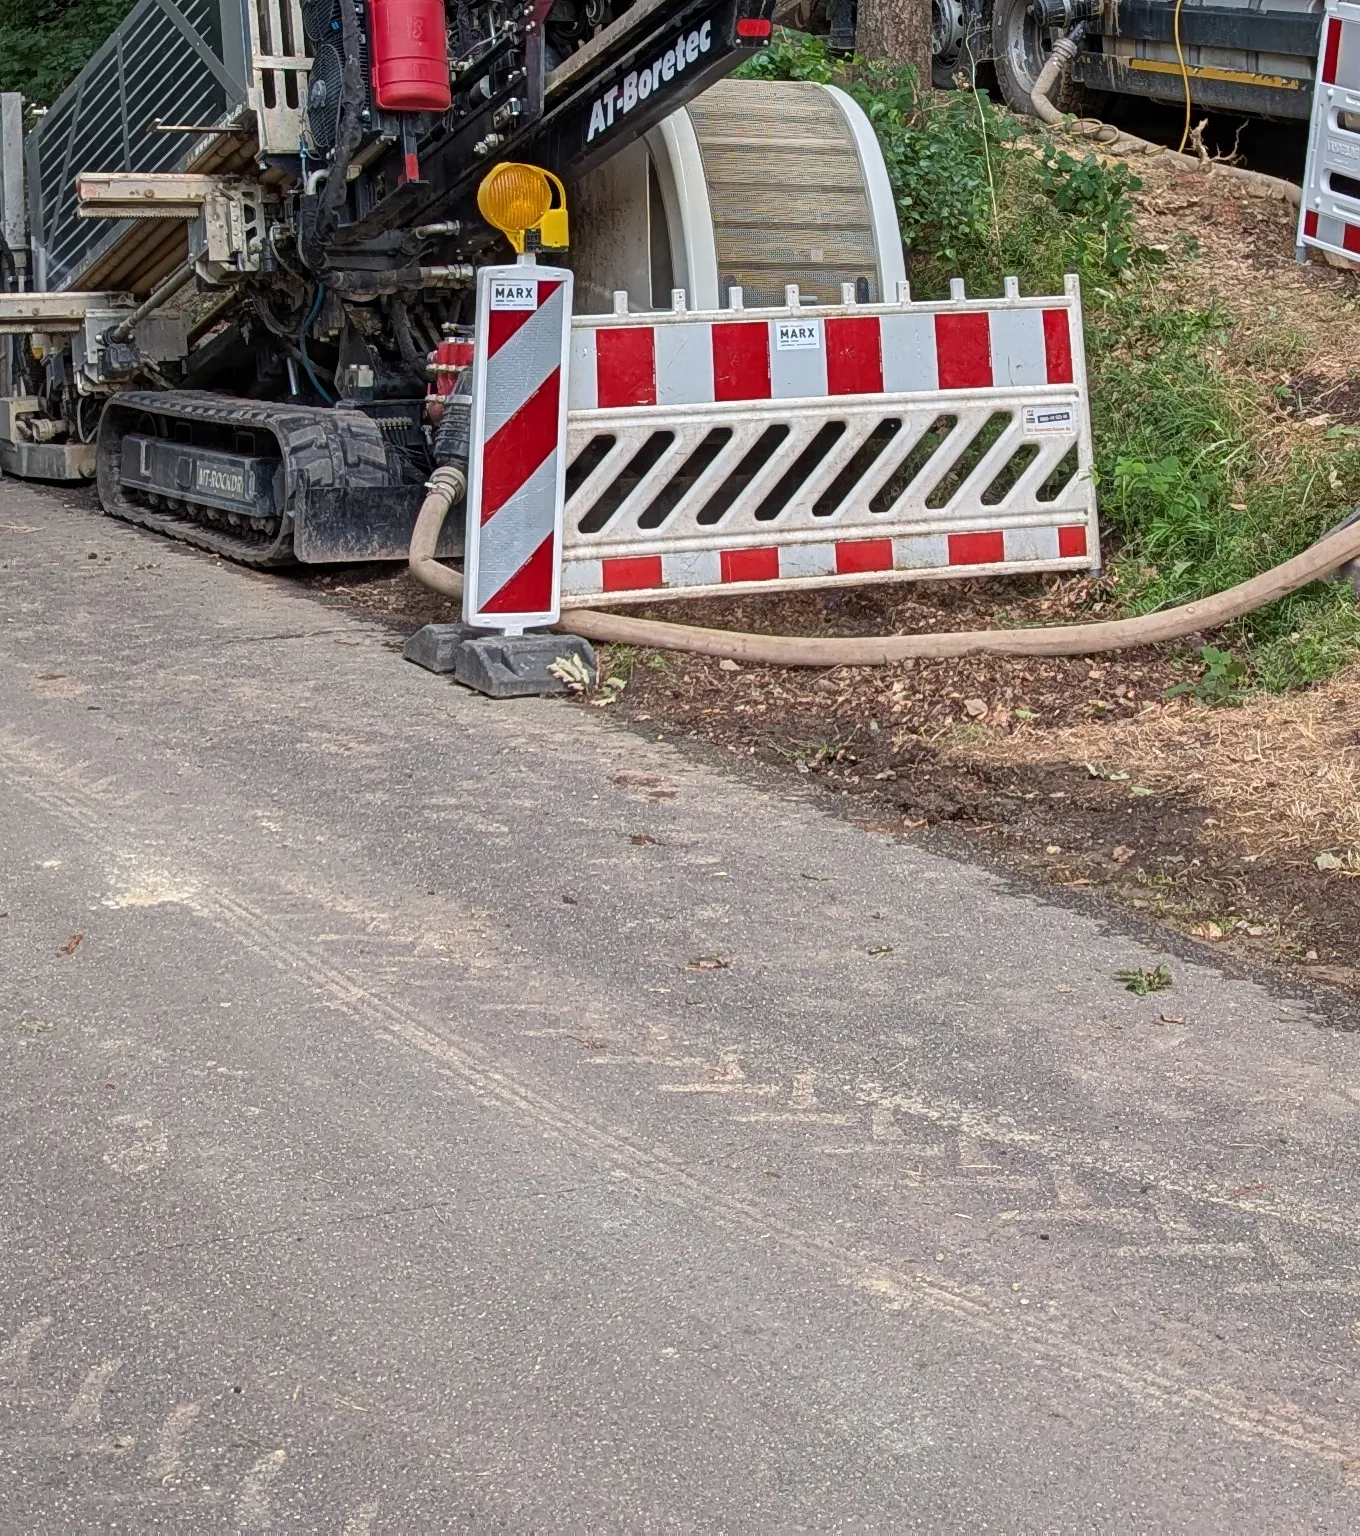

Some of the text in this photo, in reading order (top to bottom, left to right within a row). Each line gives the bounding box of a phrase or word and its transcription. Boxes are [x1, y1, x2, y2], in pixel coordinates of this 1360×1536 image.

[586, 19, 712, 143] AT-Boretec
[495, 287, 533, 299] MARX
[780, 328, 815, 340] MARX
